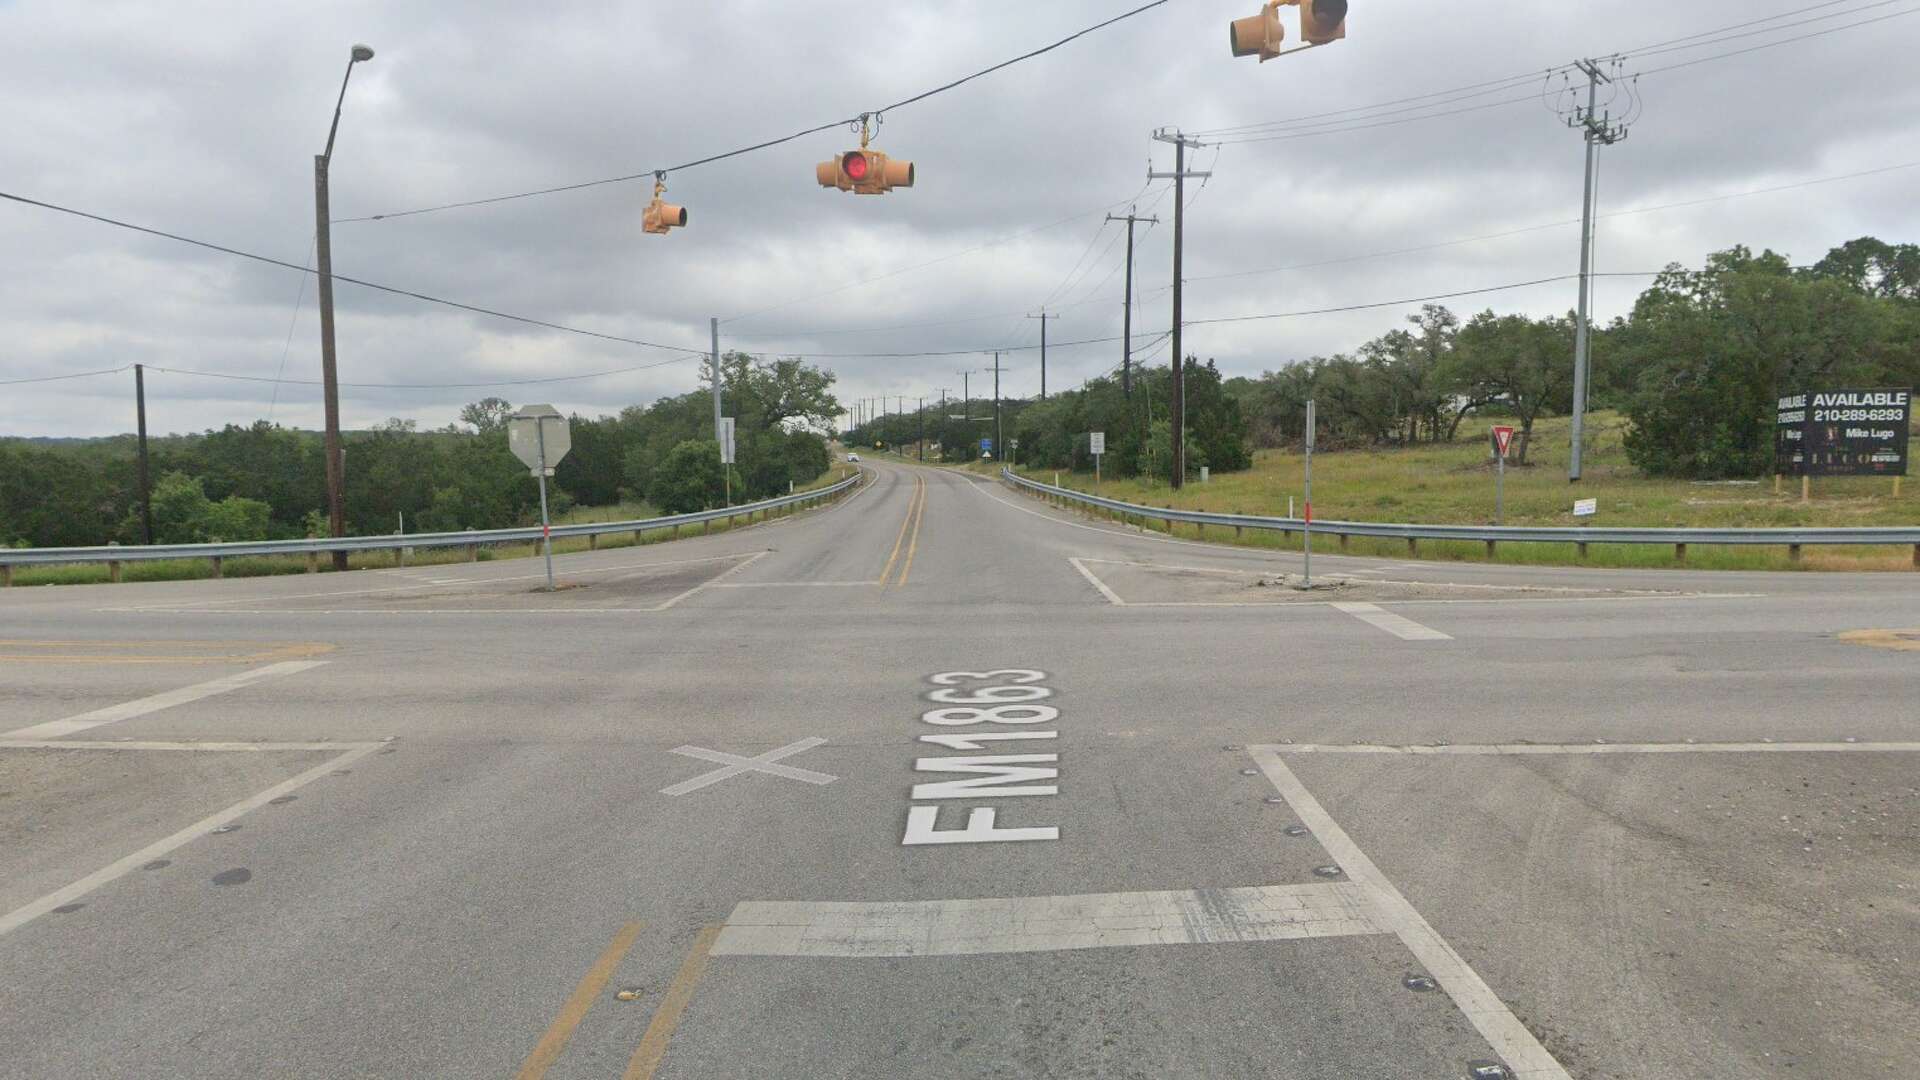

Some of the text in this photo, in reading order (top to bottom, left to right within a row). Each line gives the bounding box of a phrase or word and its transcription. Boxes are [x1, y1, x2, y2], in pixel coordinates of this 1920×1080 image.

[1813, 392, 1907, 406] AVAILABLE
[1814, 409, 1903, 421] 210-289-6293
[1846, 428, 1895, 440] Mike Lugo
